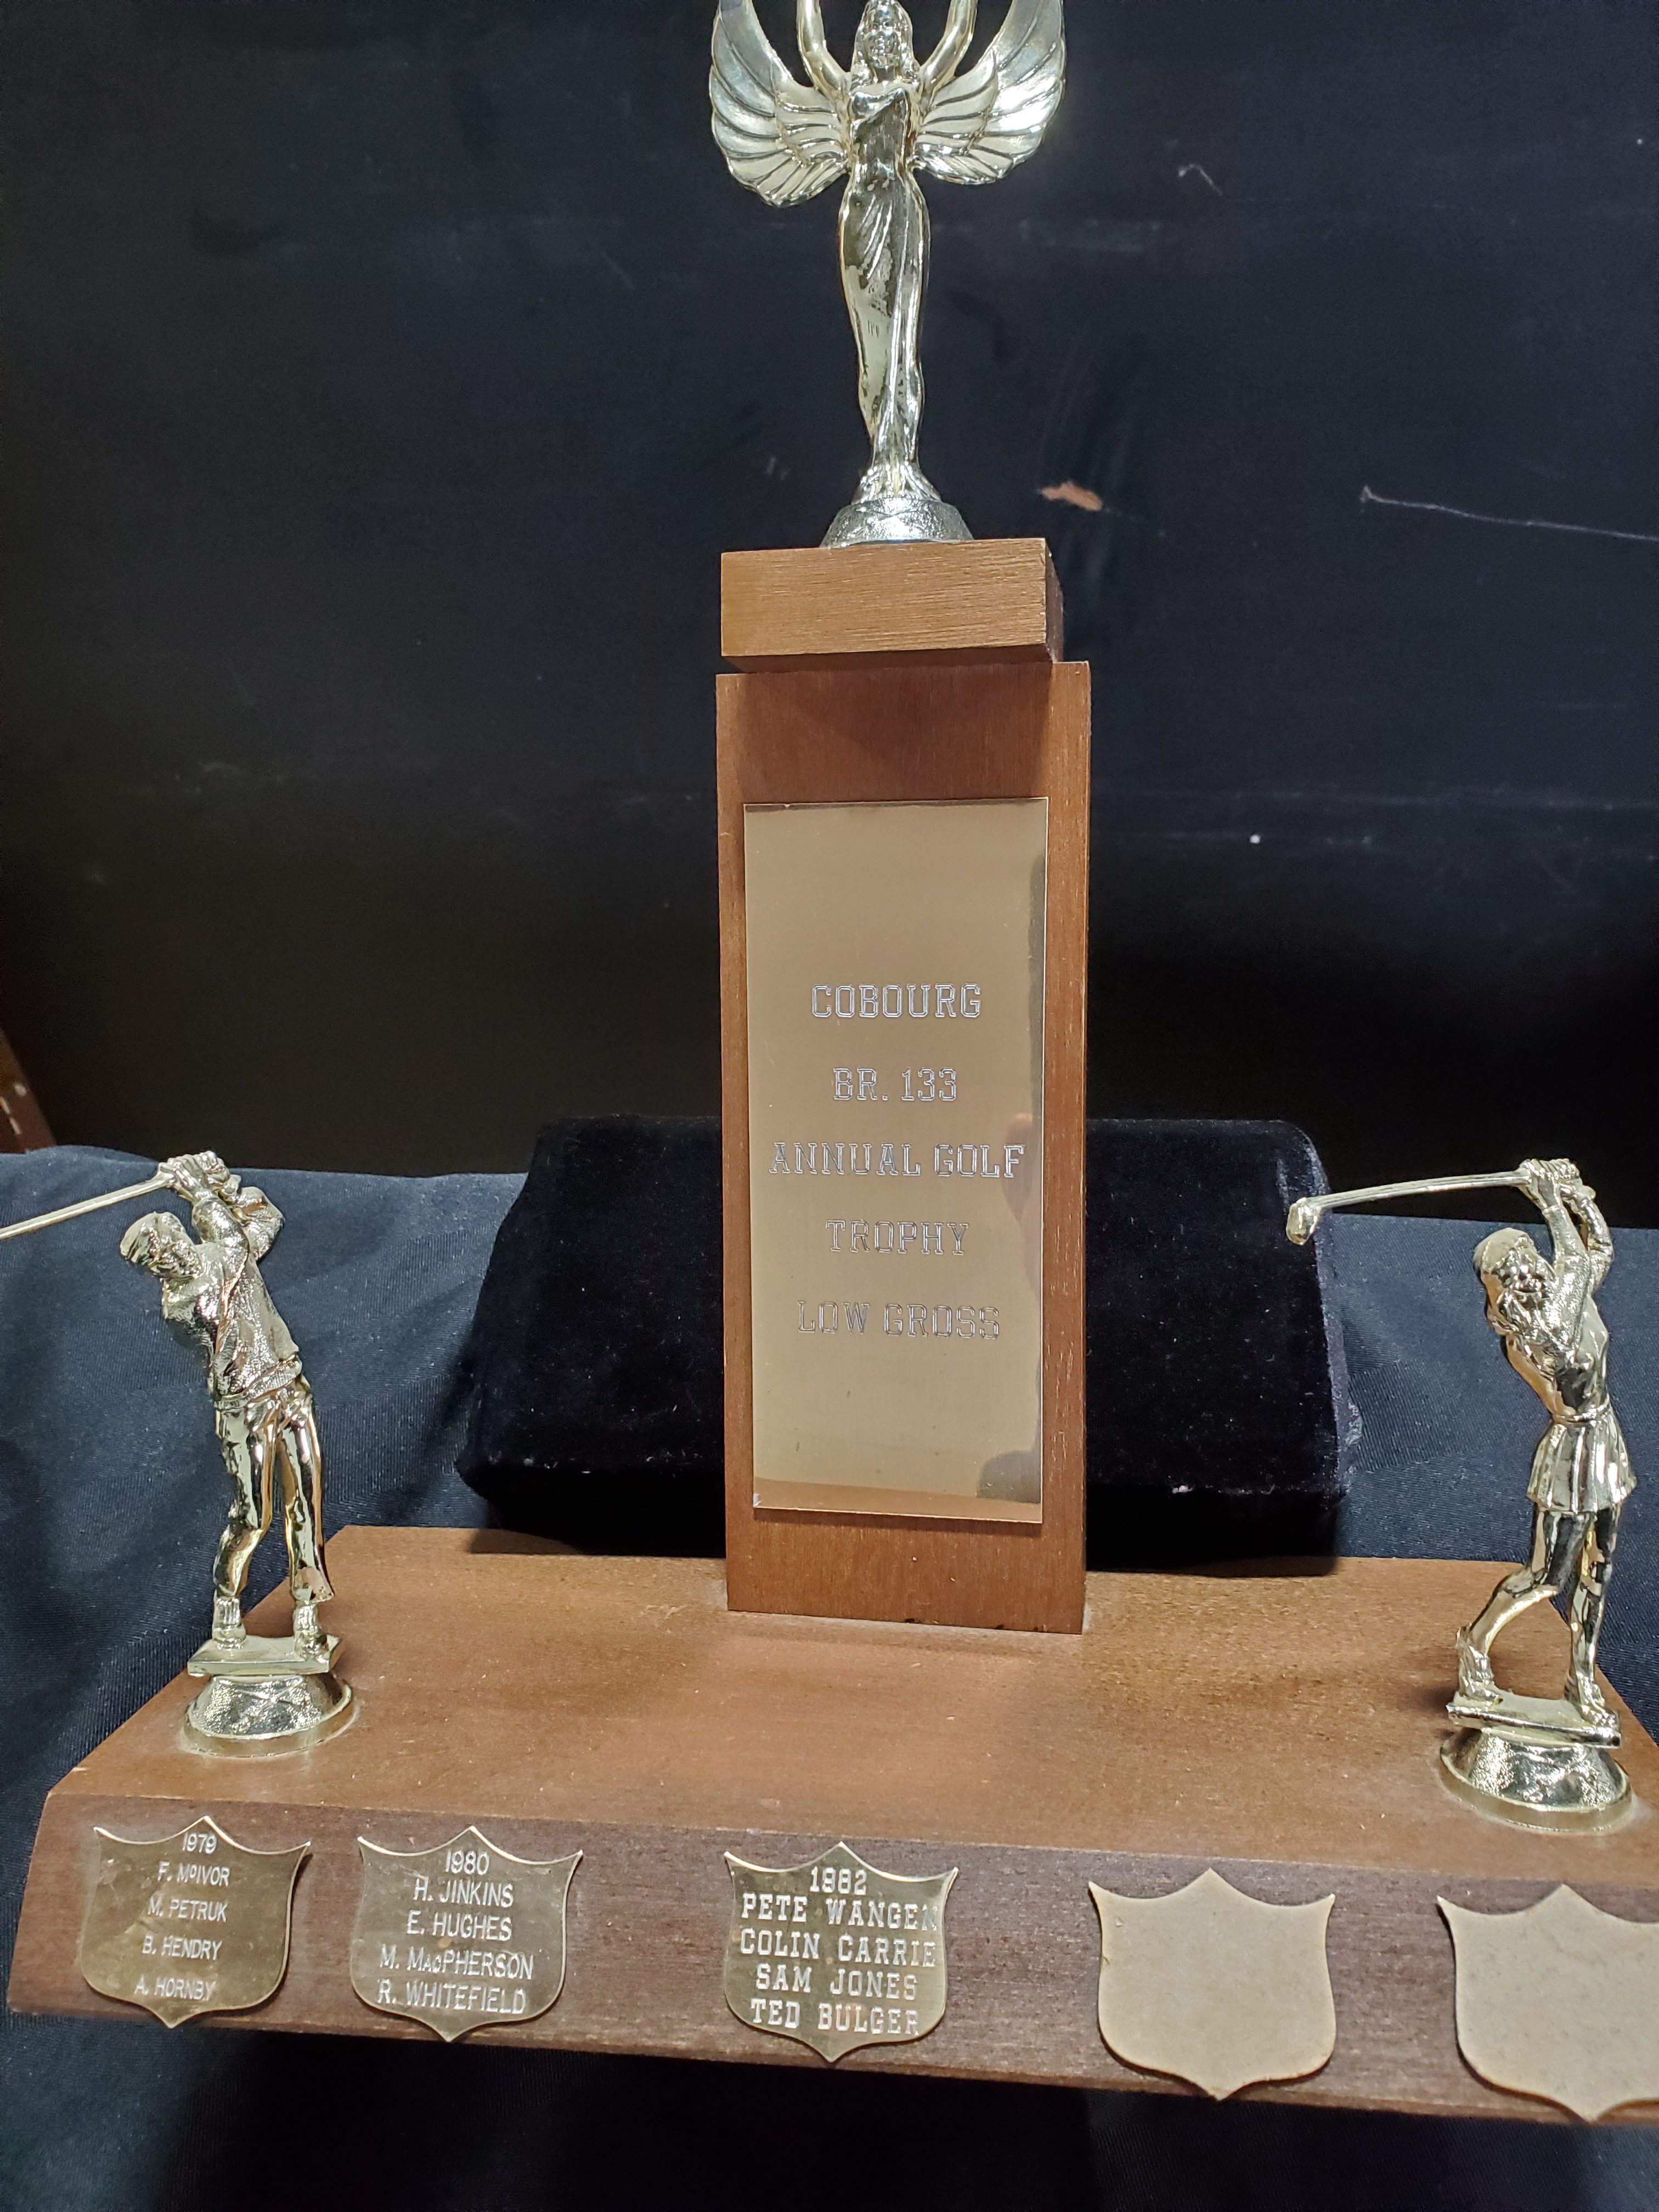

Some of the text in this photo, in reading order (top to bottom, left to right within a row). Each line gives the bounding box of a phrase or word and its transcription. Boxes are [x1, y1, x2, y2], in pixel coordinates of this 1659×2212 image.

[811, 983, 981, 1018] COBOURG
[833, 1067, 957, 1102] BR. 133
[769, 1142, 1025, 1178] ANNUAL GOLF
[825, 1219, 969, 1255] TROPHY
[797, 1300, 999, 1340] LOW GROSS
[182, 1832, 217, 1854] 1979
[157, 1861, 172, 1882] F.
[445, 1849, 490, 1876] 1980
[439, 1878, 514, 1909] JINKINS
[809, 1865, 867, 1895] 1982
[148, 1897, 228, 1922] M. PETRUK
[407, 1909, 512, 1942] E. HUGHES
[741, 1893, 939, 1931] PETE WANGEN
[142, 1934, 223, 1961] B. HENDRY
[379, 1943, 400, 1970] M.
[740, 1927, 936, 1967] COLIN CARRIE
[134, 1975, 216, 2002] A. HORNBY
[377, 1978, 526, 2015] R. WHITEFIELD
[755, 1962, 917, 2001] SAM JONES
[751, 1998, 919, 2036] TED BULGER
